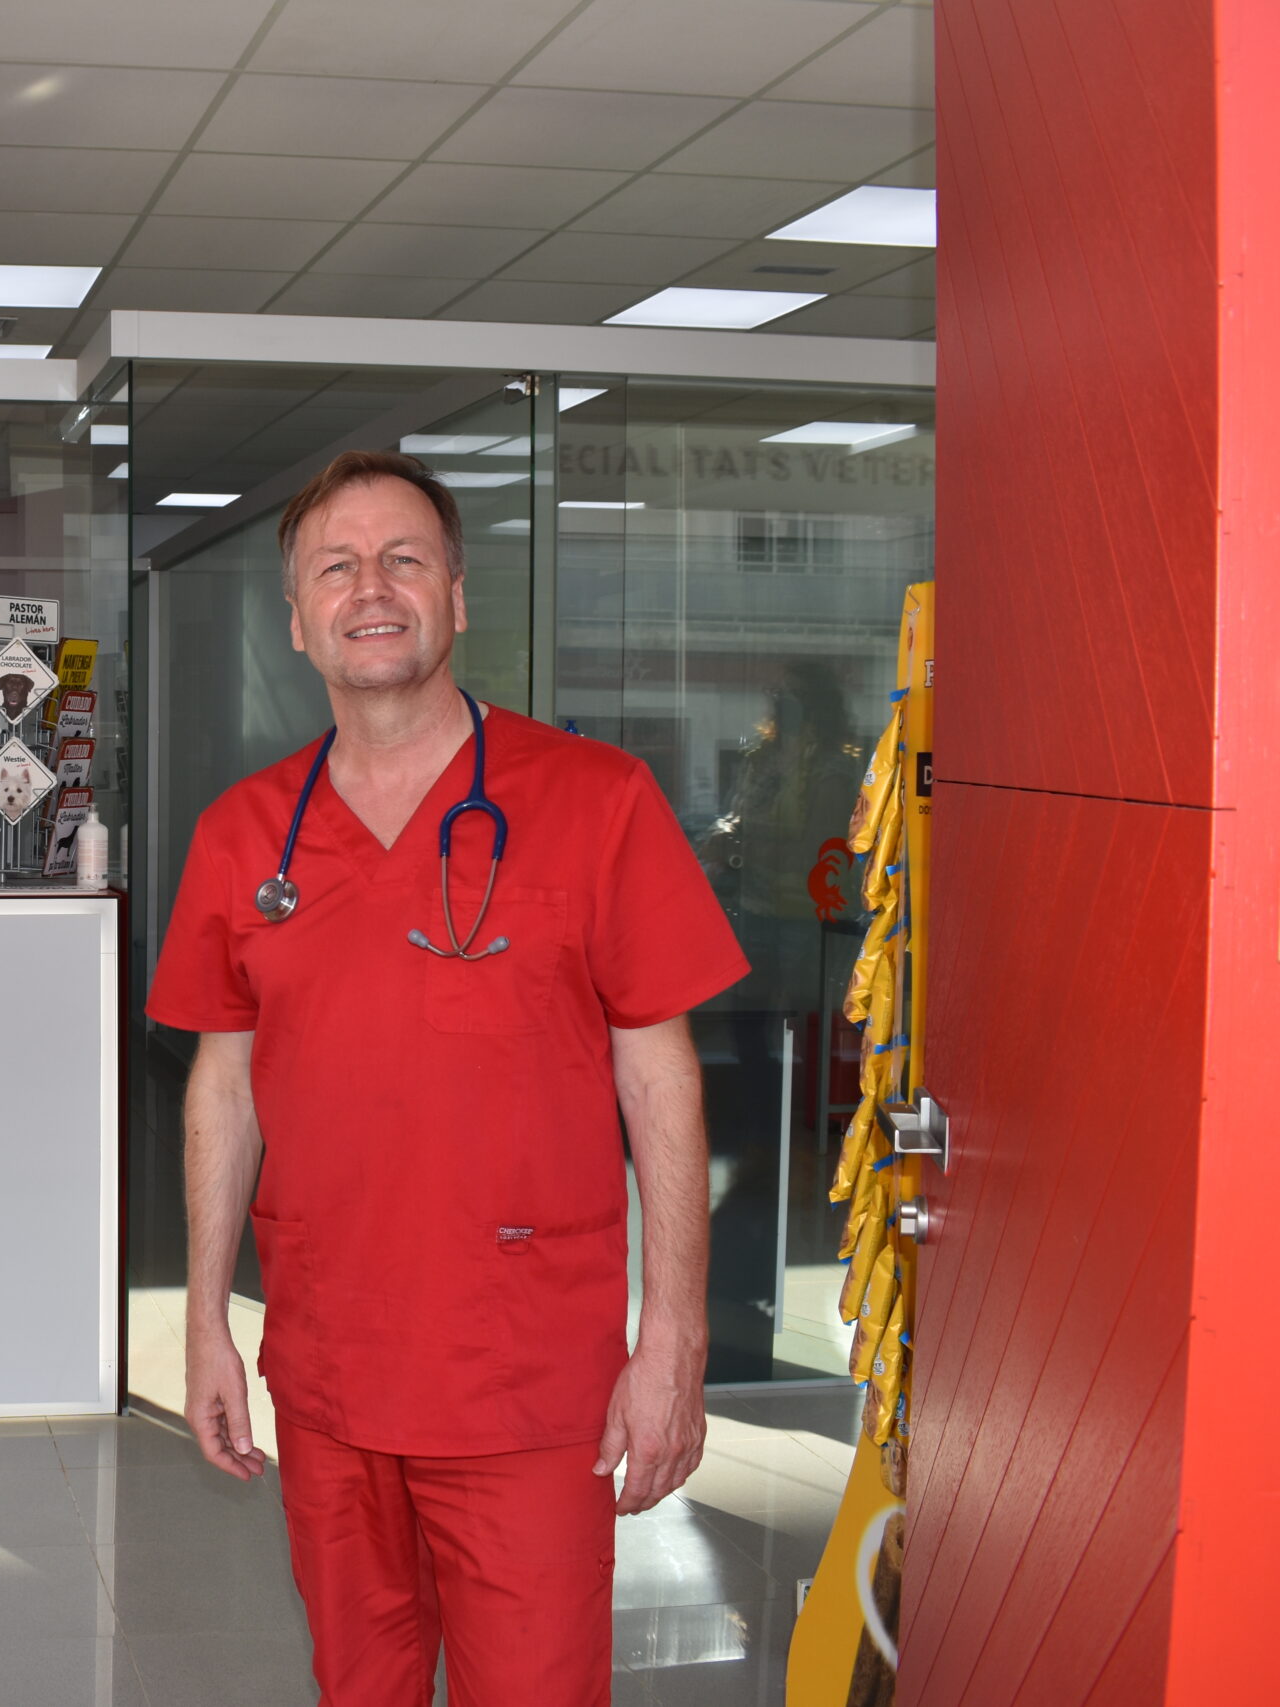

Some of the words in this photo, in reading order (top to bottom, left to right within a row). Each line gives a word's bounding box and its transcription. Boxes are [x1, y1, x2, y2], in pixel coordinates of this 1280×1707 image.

[9, 602, 44, 614] PASTOR
[9, 613, 47, 626] ALEMÁN
[0, 661, 33, 669] CHOCOLATE
